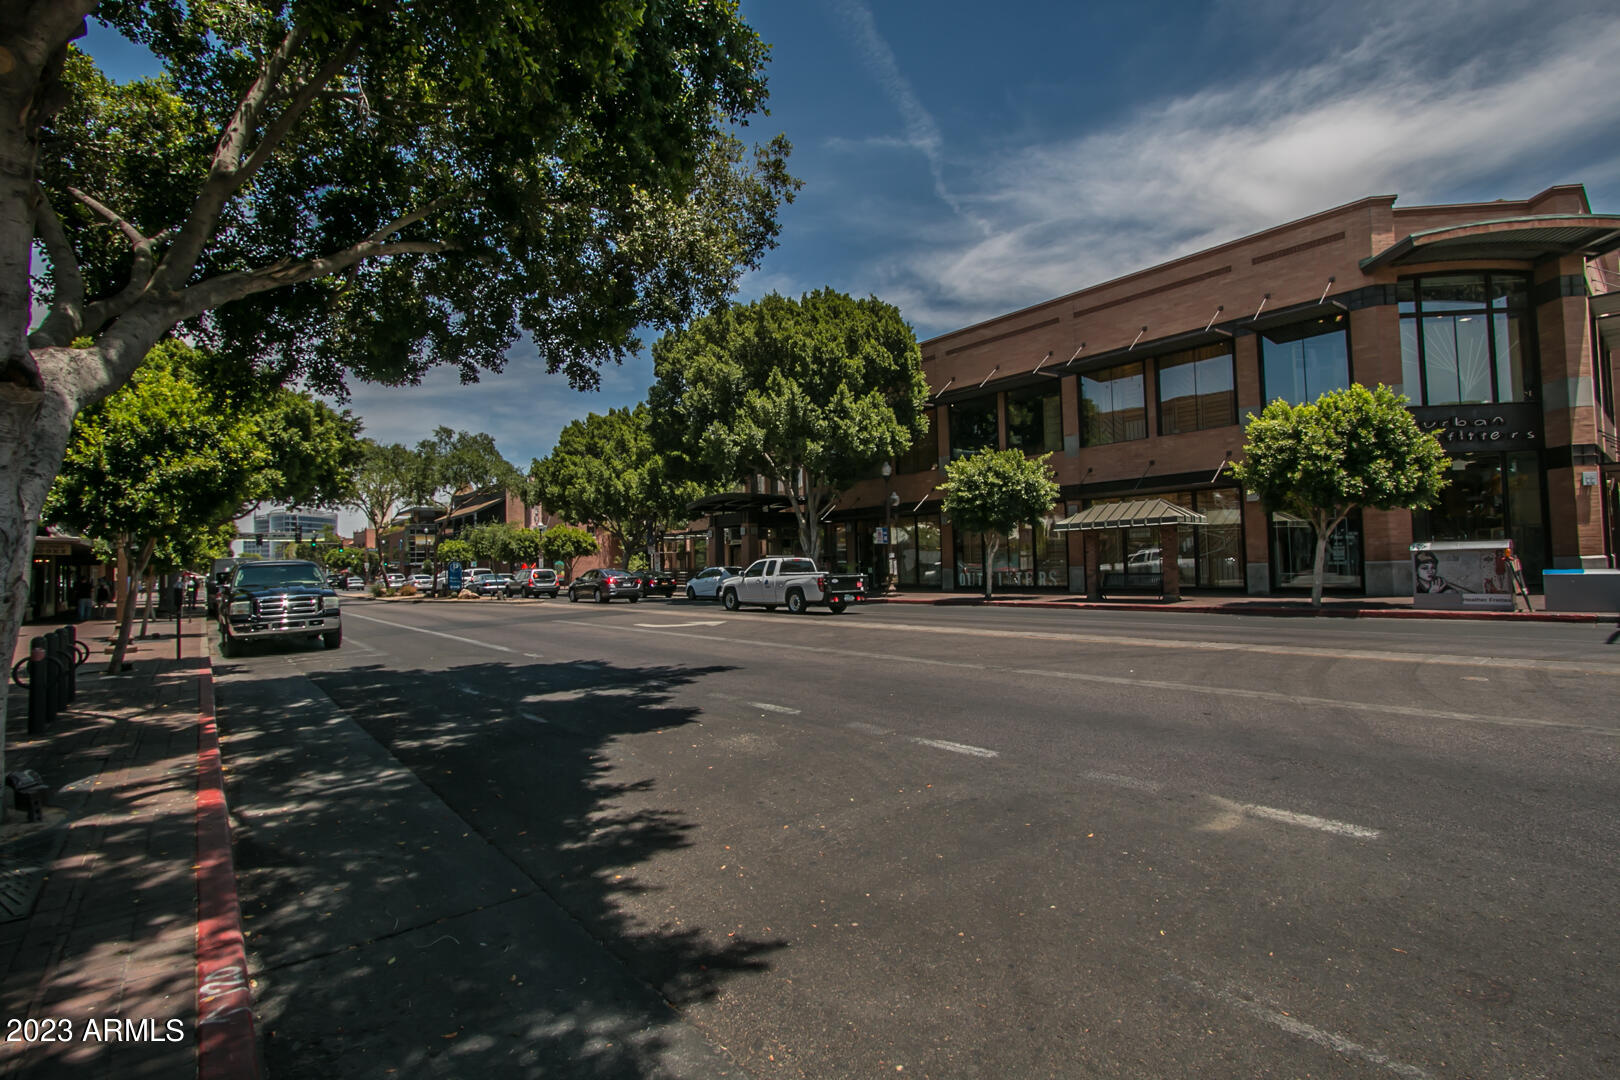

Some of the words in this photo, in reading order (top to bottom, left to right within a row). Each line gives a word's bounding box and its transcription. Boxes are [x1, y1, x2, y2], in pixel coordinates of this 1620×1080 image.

[1423, 416, 1504, 428] urban
[1437, 431, 1536, 441] fitters
[958, 570, 1057, 587] OUTITTERS
